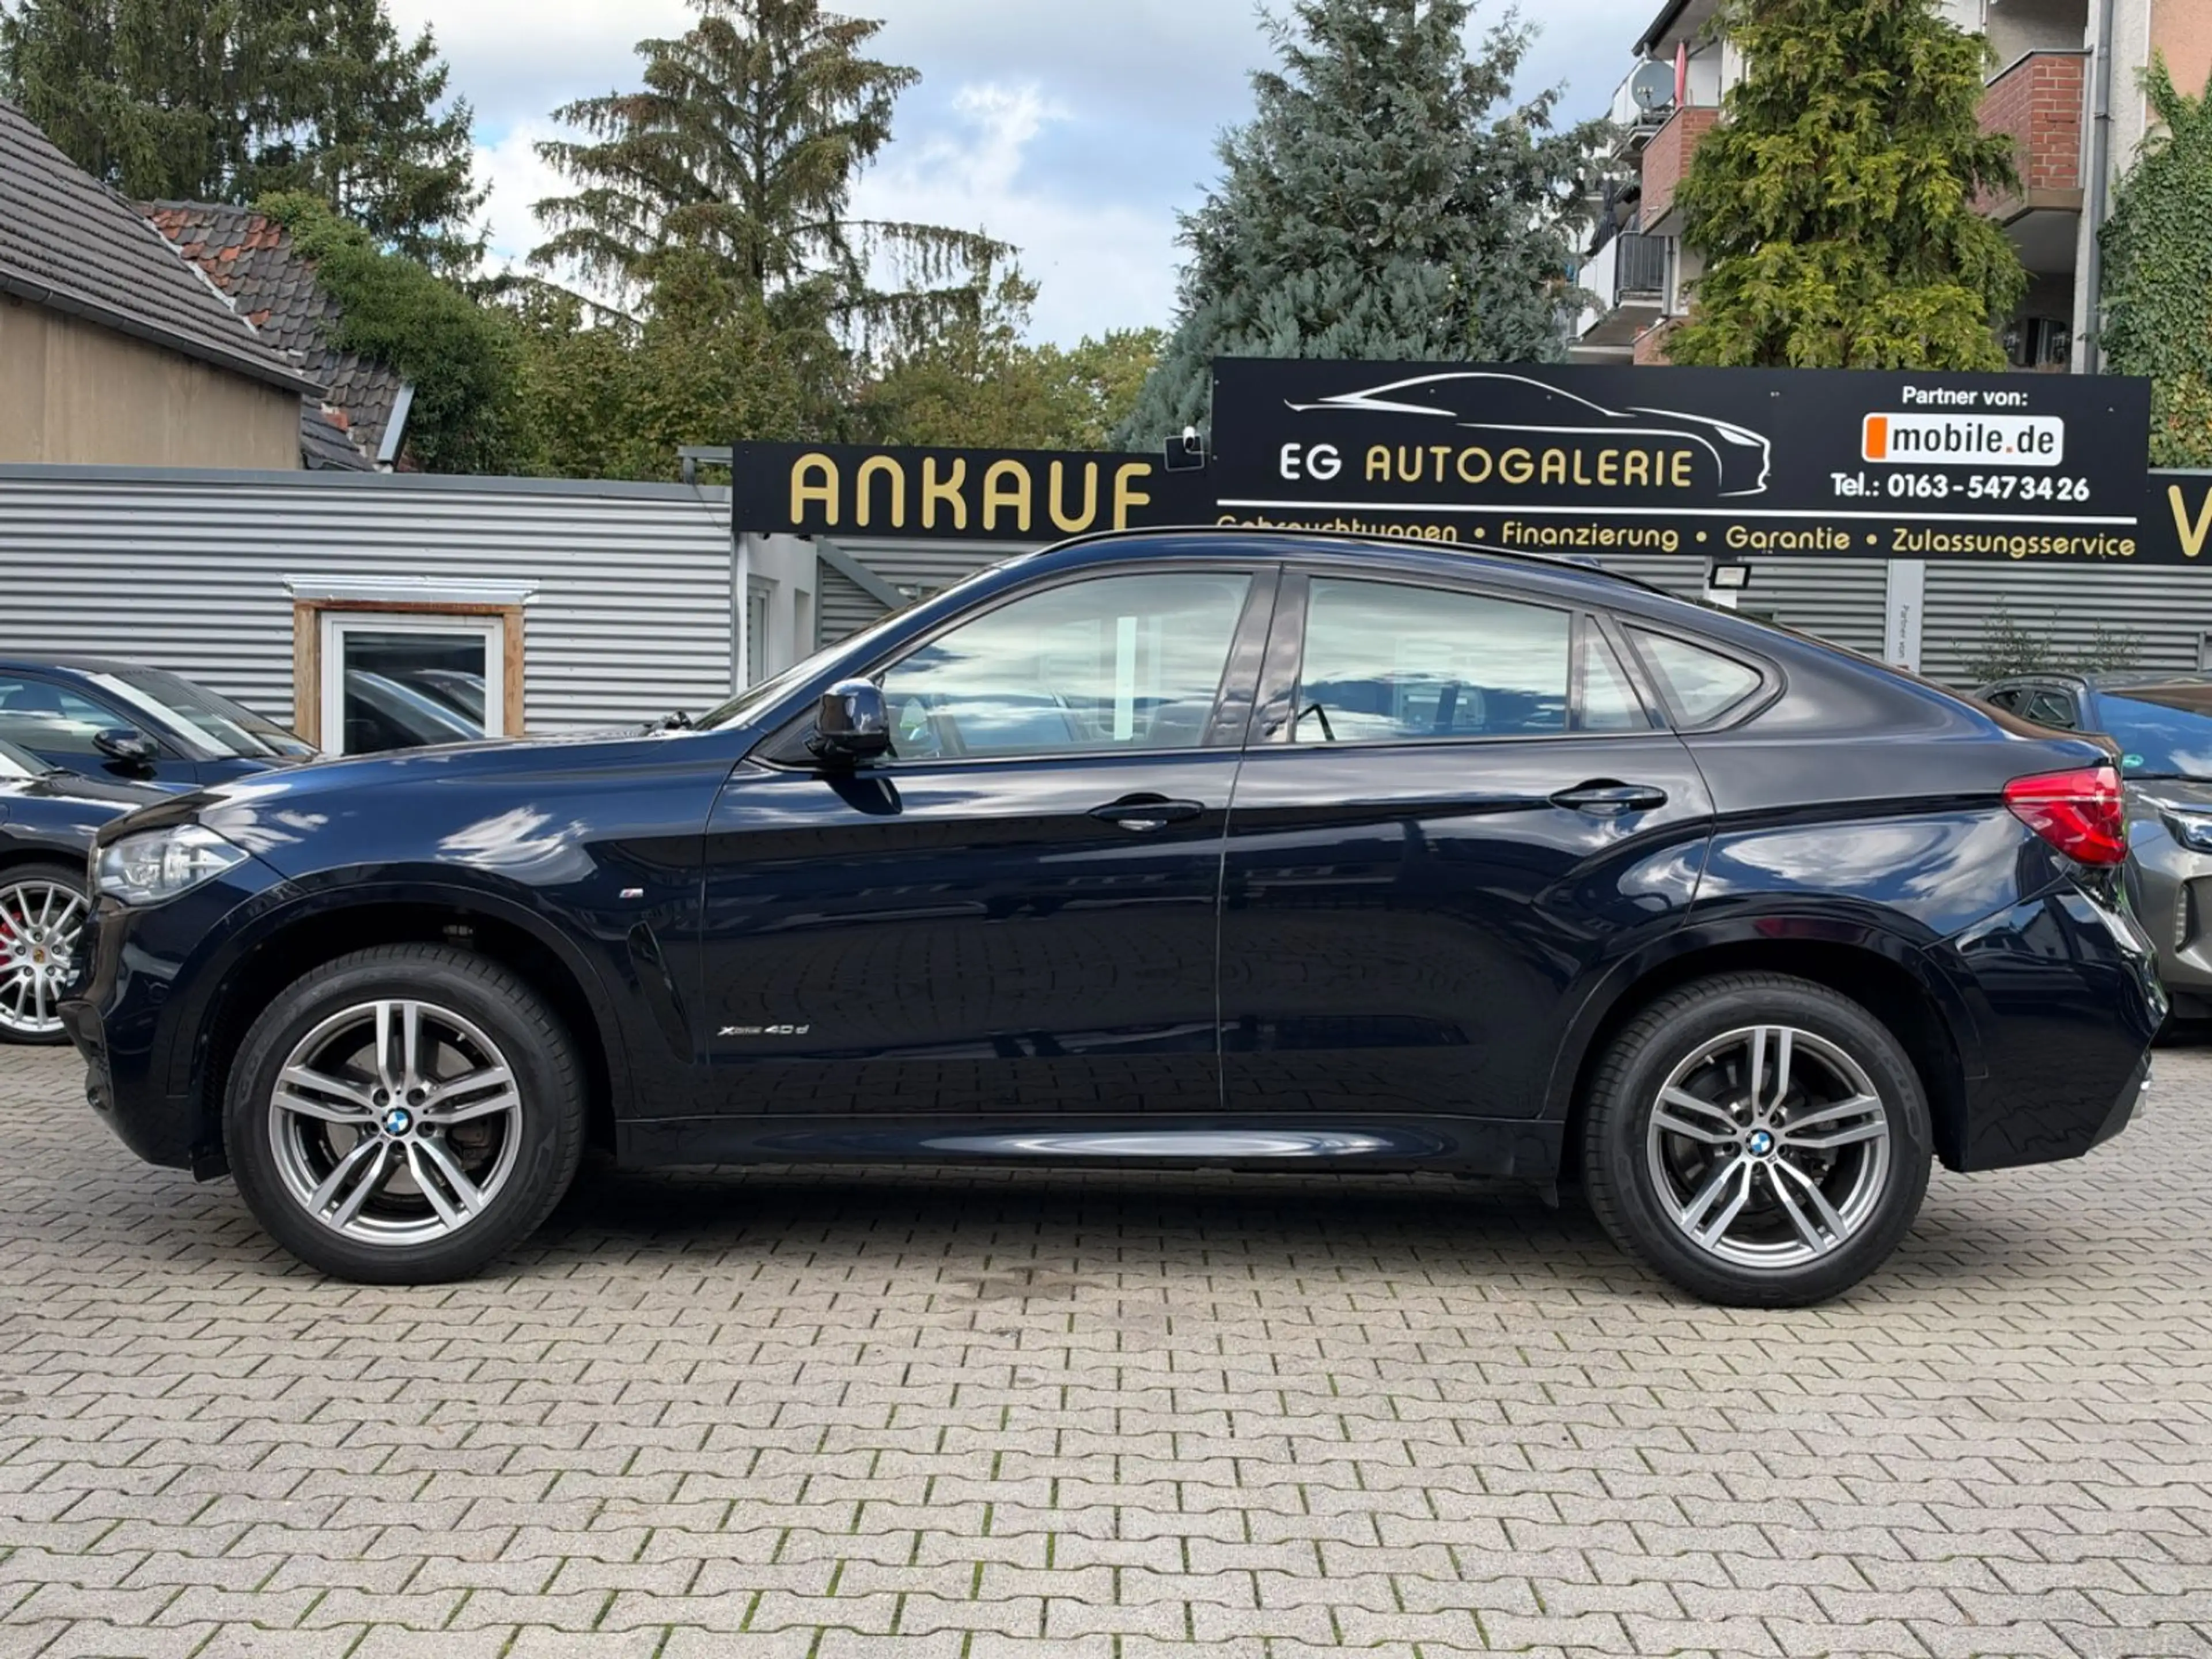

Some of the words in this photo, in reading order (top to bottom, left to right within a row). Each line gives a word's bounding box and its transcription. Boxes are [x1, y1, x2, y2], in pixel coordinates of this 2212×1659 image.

[1902, 385, 1978, 405] Partner
[1983, 391, 2028, 406] von:
[1892, 423, 2054, 454] mobile.de
[1280, 442, 1342, 480] EG
[1366, 445, 1692, 487] AUTOGALERIE
[791, 452, 1152, 532] ANKAUF
[1830, 471, 1879, 497] Tel.:
[1502, 521, 1679, 552] Finanzierung
[1725, 525, 1850, 550] Garantie
[1892, 528, 2135, 559] Zulassungsservice
